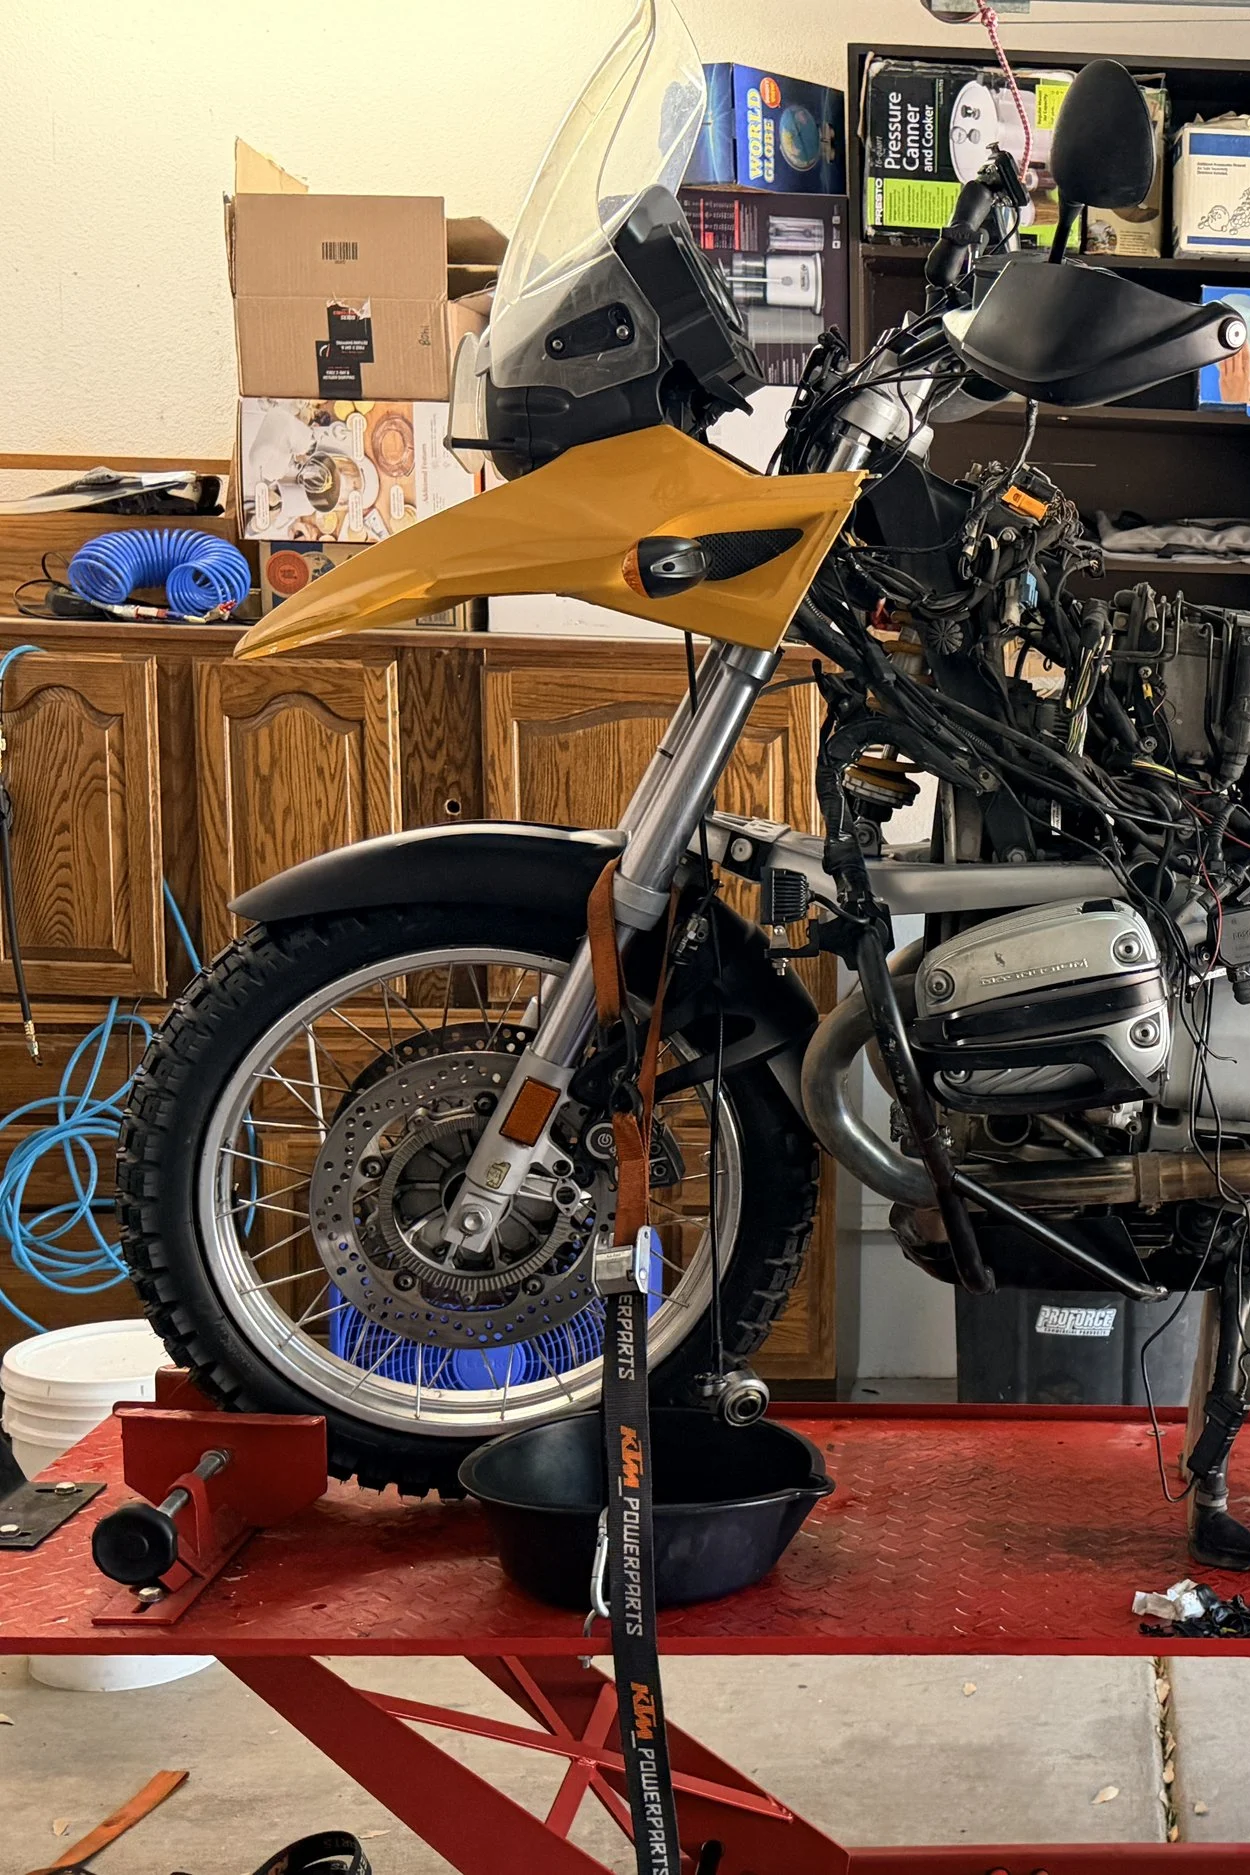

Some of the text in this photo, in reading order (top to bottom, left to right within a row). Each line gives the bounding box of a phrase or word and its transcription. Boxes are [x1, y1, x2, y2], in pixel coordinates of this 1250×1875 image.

[747, 88, 763, 180] WORLD
[764, 118, 775, 183] GLOBE
[884, 92, 902, 169] Pressure
[902, 103, 920, 171] Canner
[921, 104, 934, 173] and Cooker
[874, 177, 884, 226] PRESTO
[1036, 1306, 1115, 1331] PROFORCE
[620, 1425, 644, 1637] KTM POWERPARTS
[630, 1681, 670, 1875] KTM POWERPARTS
